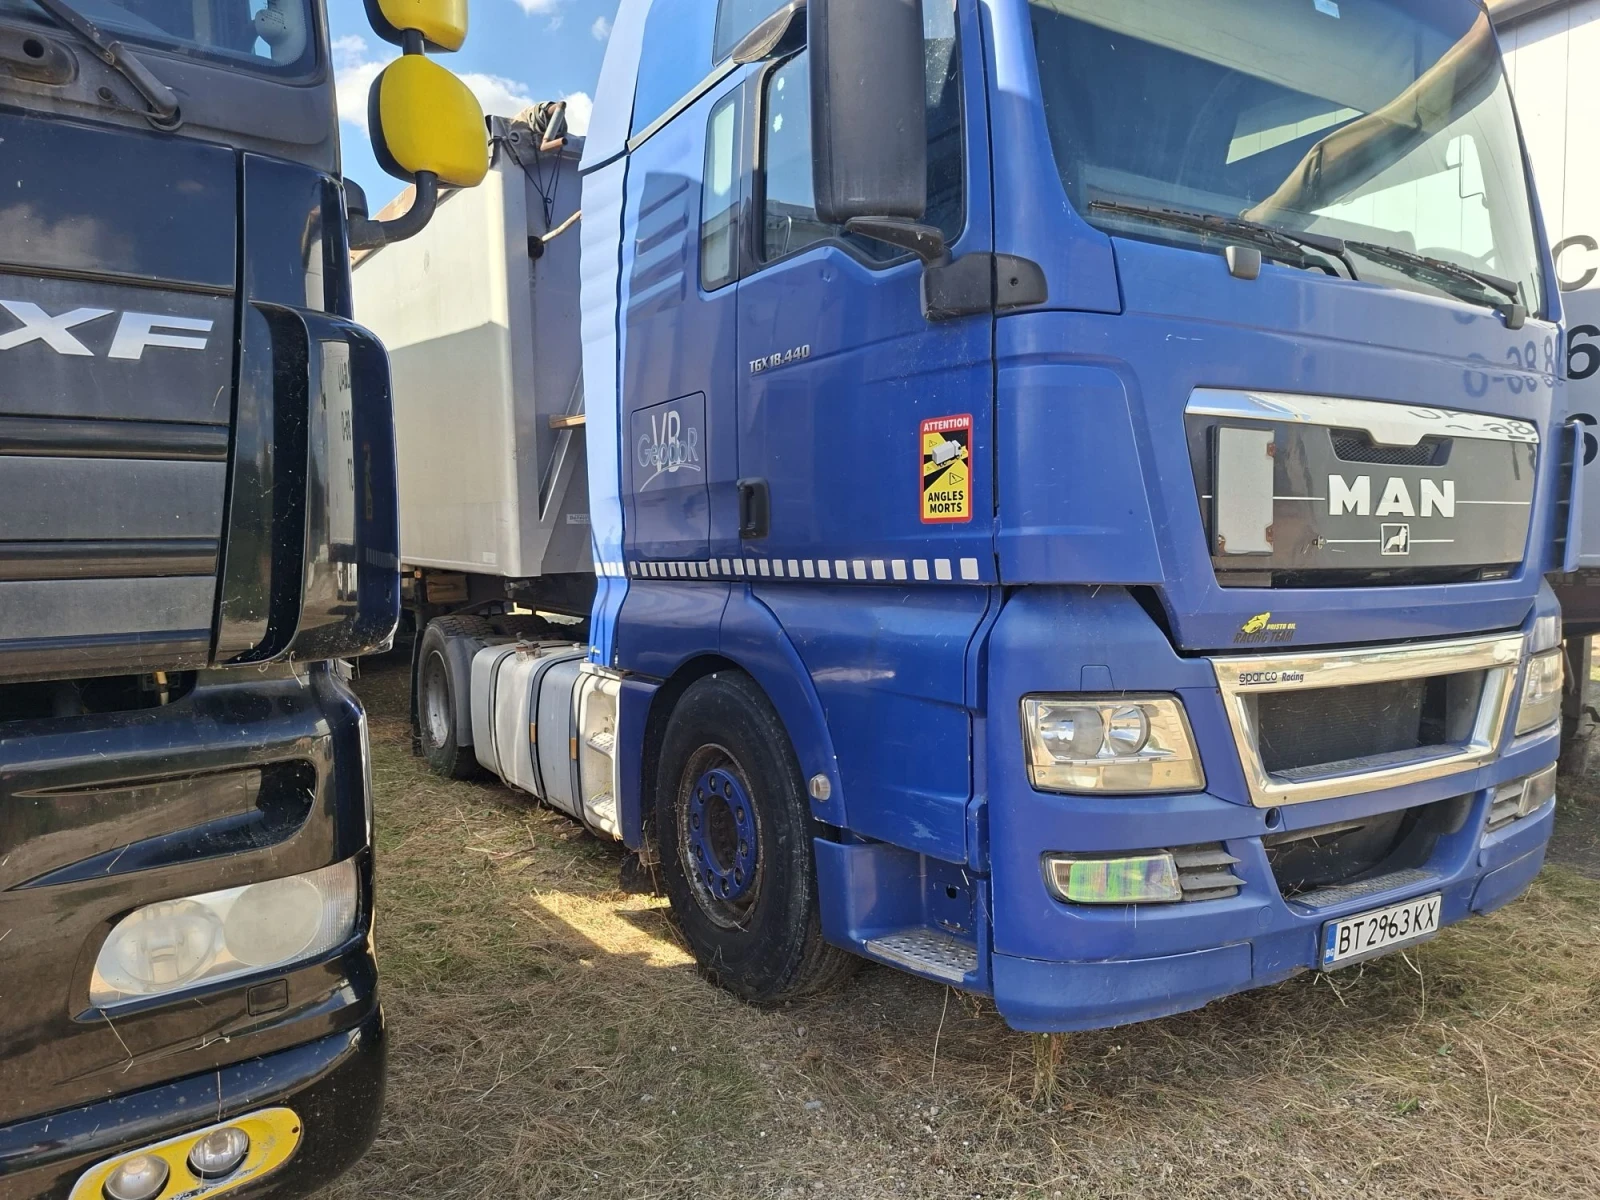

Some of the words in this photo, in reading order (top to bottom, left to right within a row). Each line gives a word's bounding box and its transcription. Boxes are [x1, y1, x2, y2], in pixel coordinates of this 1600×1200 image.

[0, 300, 214, 359] XF
[923, 417, 970, 432] ATTENTION
[928, 490, 964, 502] ANGLES
[1328, 474, 1454, 518] MAN
[930, 502, 962, 513] MORTS
[1270, 630, 1295, 642] TEAM
[1239, 671, 1278, 685] sparco
[1281, 671, 1305, 683] Racing
